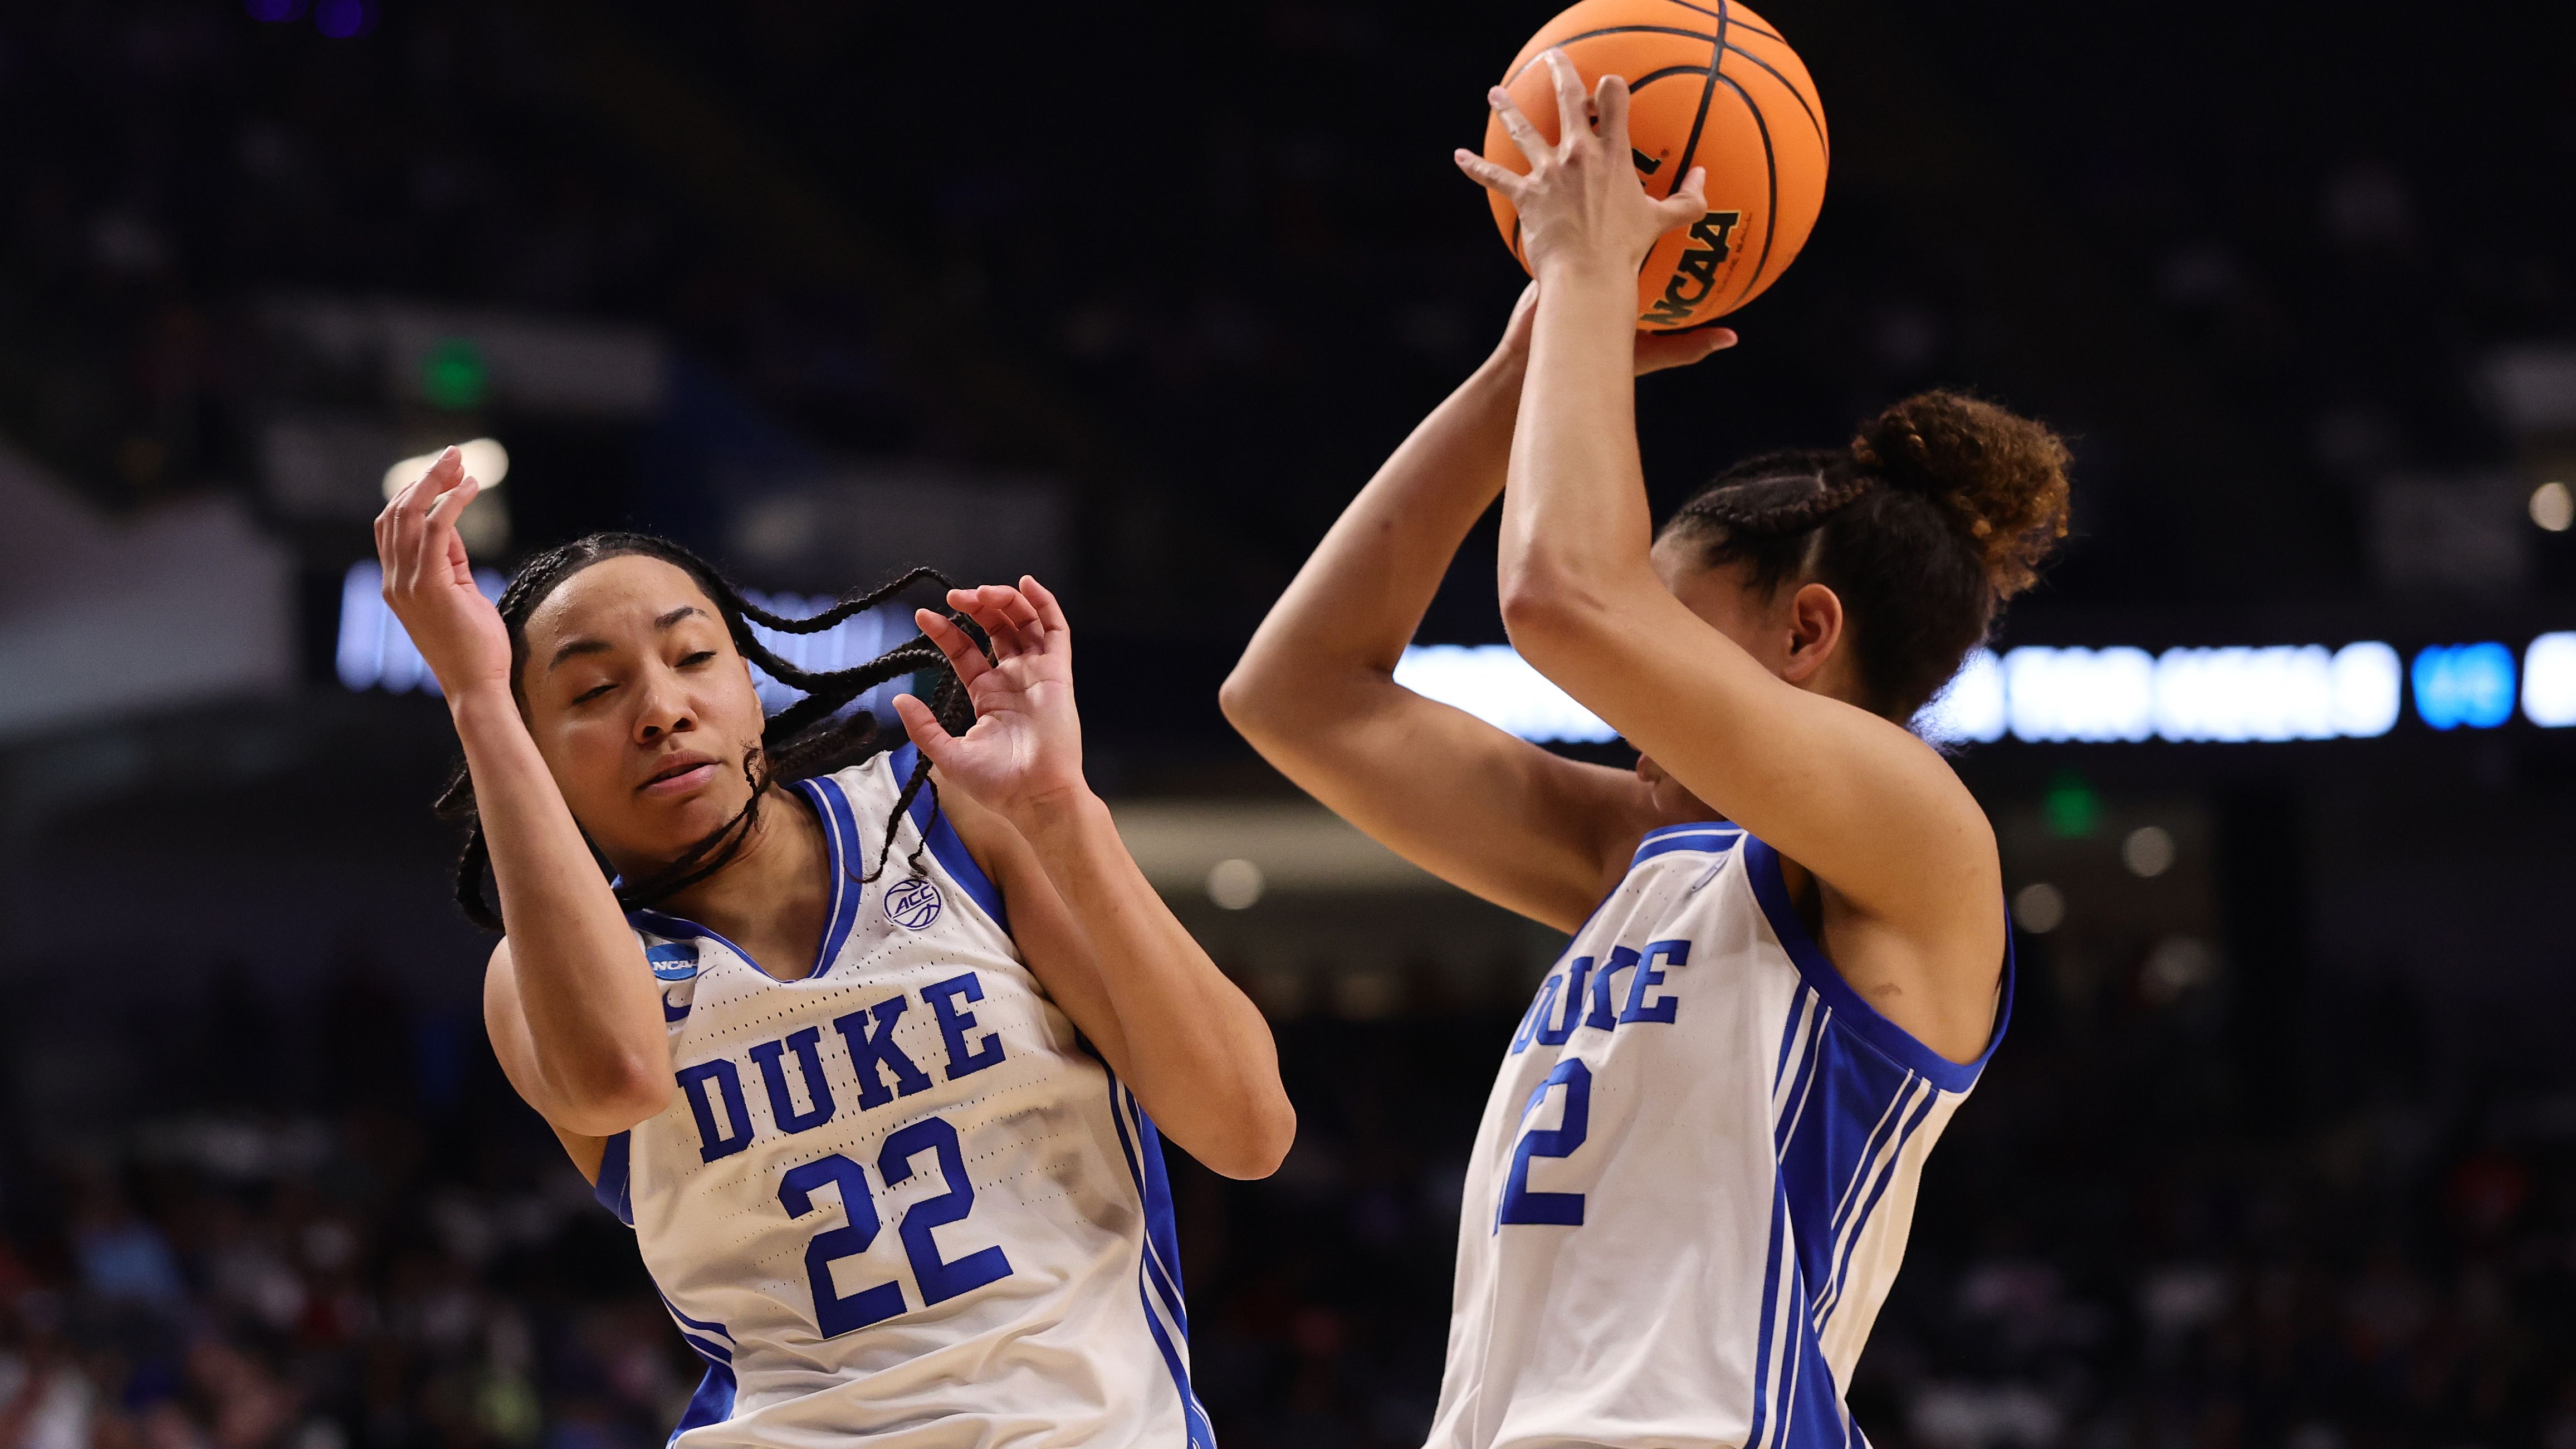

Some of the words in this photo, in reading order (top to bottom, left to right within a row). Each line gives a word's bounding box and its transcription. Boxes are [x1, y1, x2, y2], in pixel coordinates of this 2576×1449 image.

[1640, 210, 1741, 326] NCAA
[895, 884, 933, 914] ACC
[1511, 939, 1691, 1056] DUKE
[674, 972, 1006, 1163] DUKE
[777, 1117, 1015, 1340] 22
